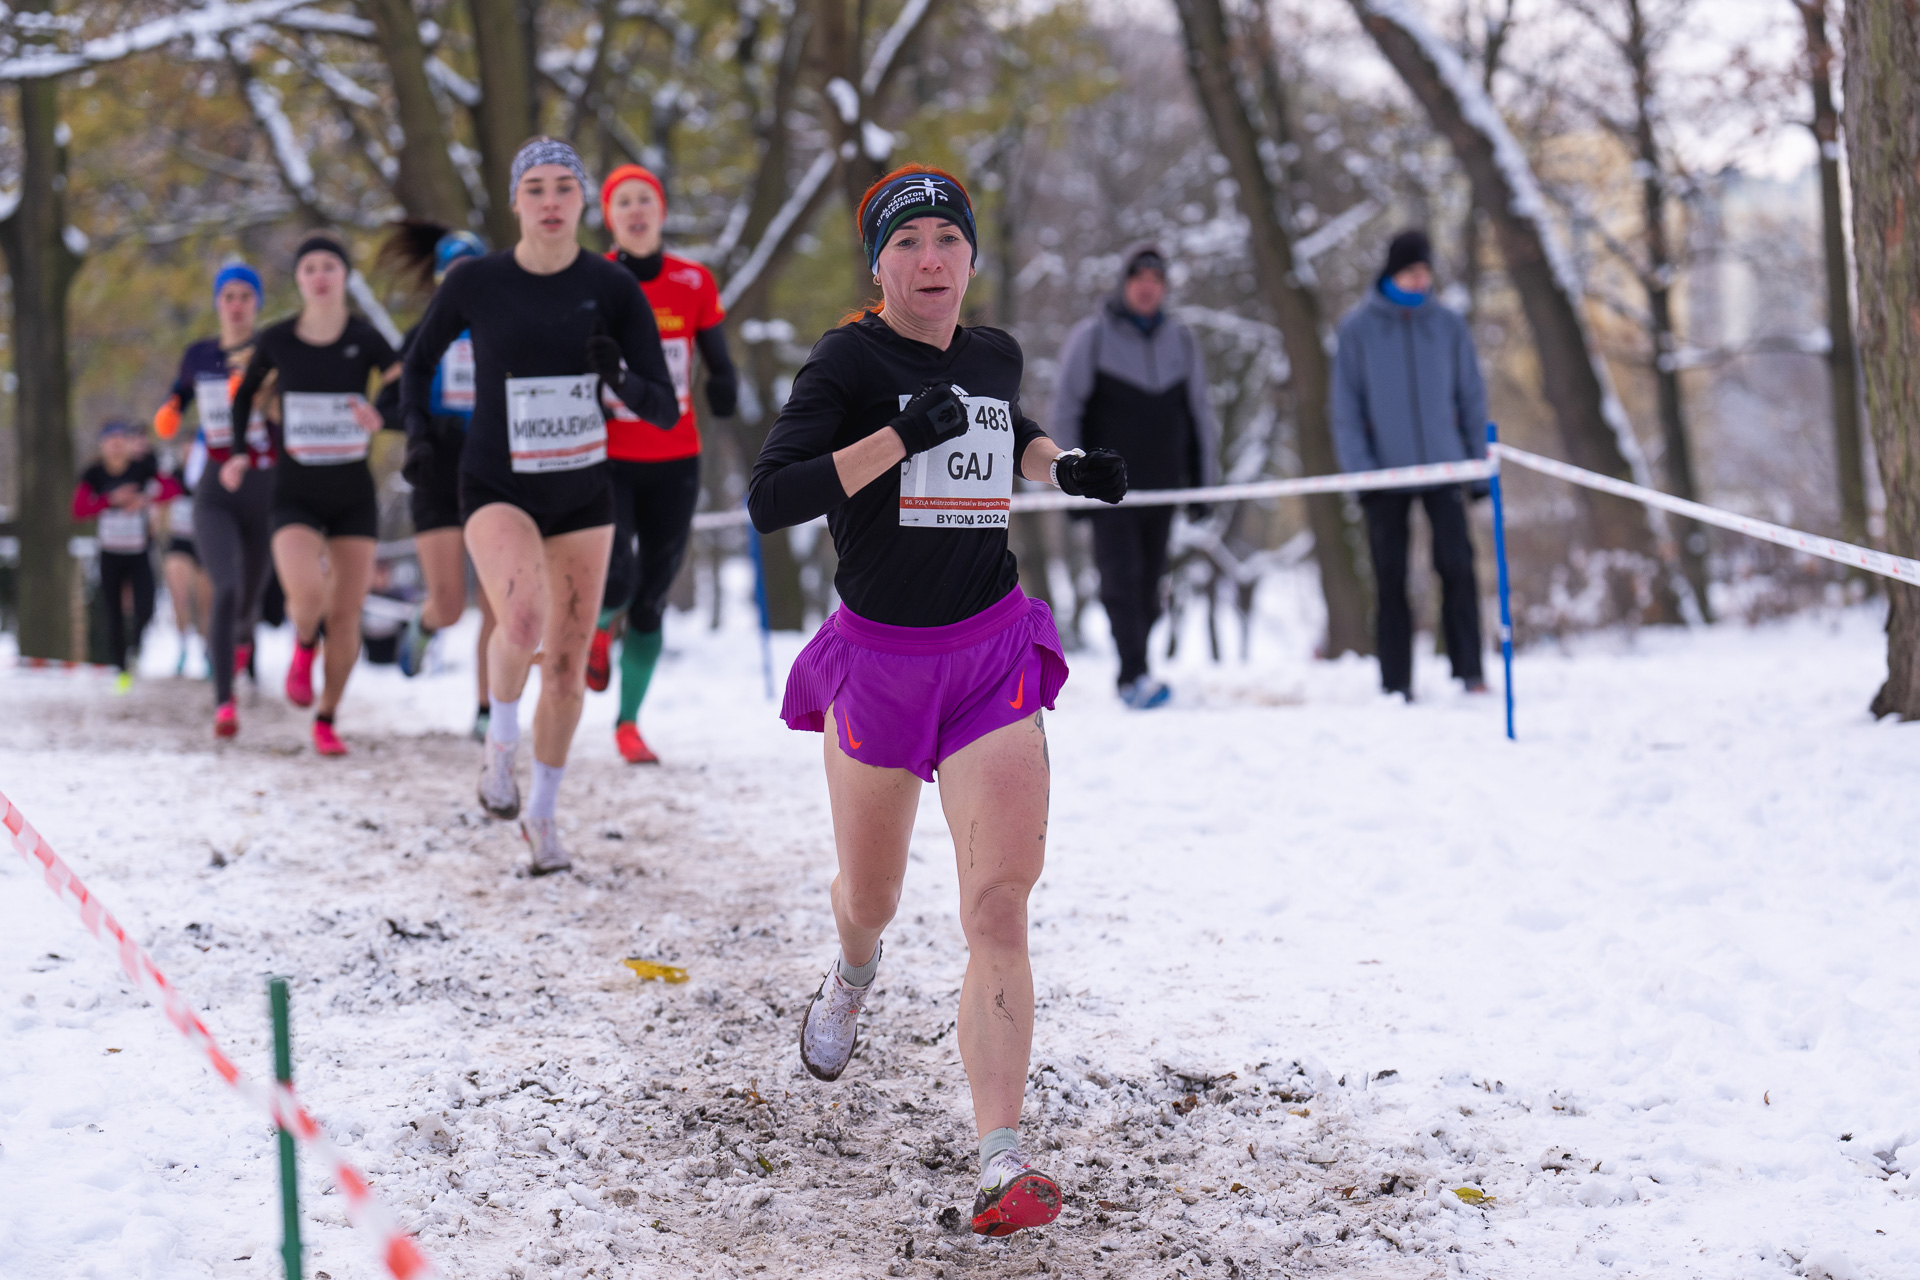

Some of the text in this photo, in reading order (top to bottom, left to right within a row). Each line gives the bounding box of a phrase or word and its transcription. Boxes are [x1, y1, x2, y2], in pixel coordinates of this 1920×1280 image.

[974, 405, 1009, 432] 483
[947, 451, 994, 481] GAJ
[977, 500, 1000, 508] Biegach
[936, 514, 1007, 524] BYTOM 2024
